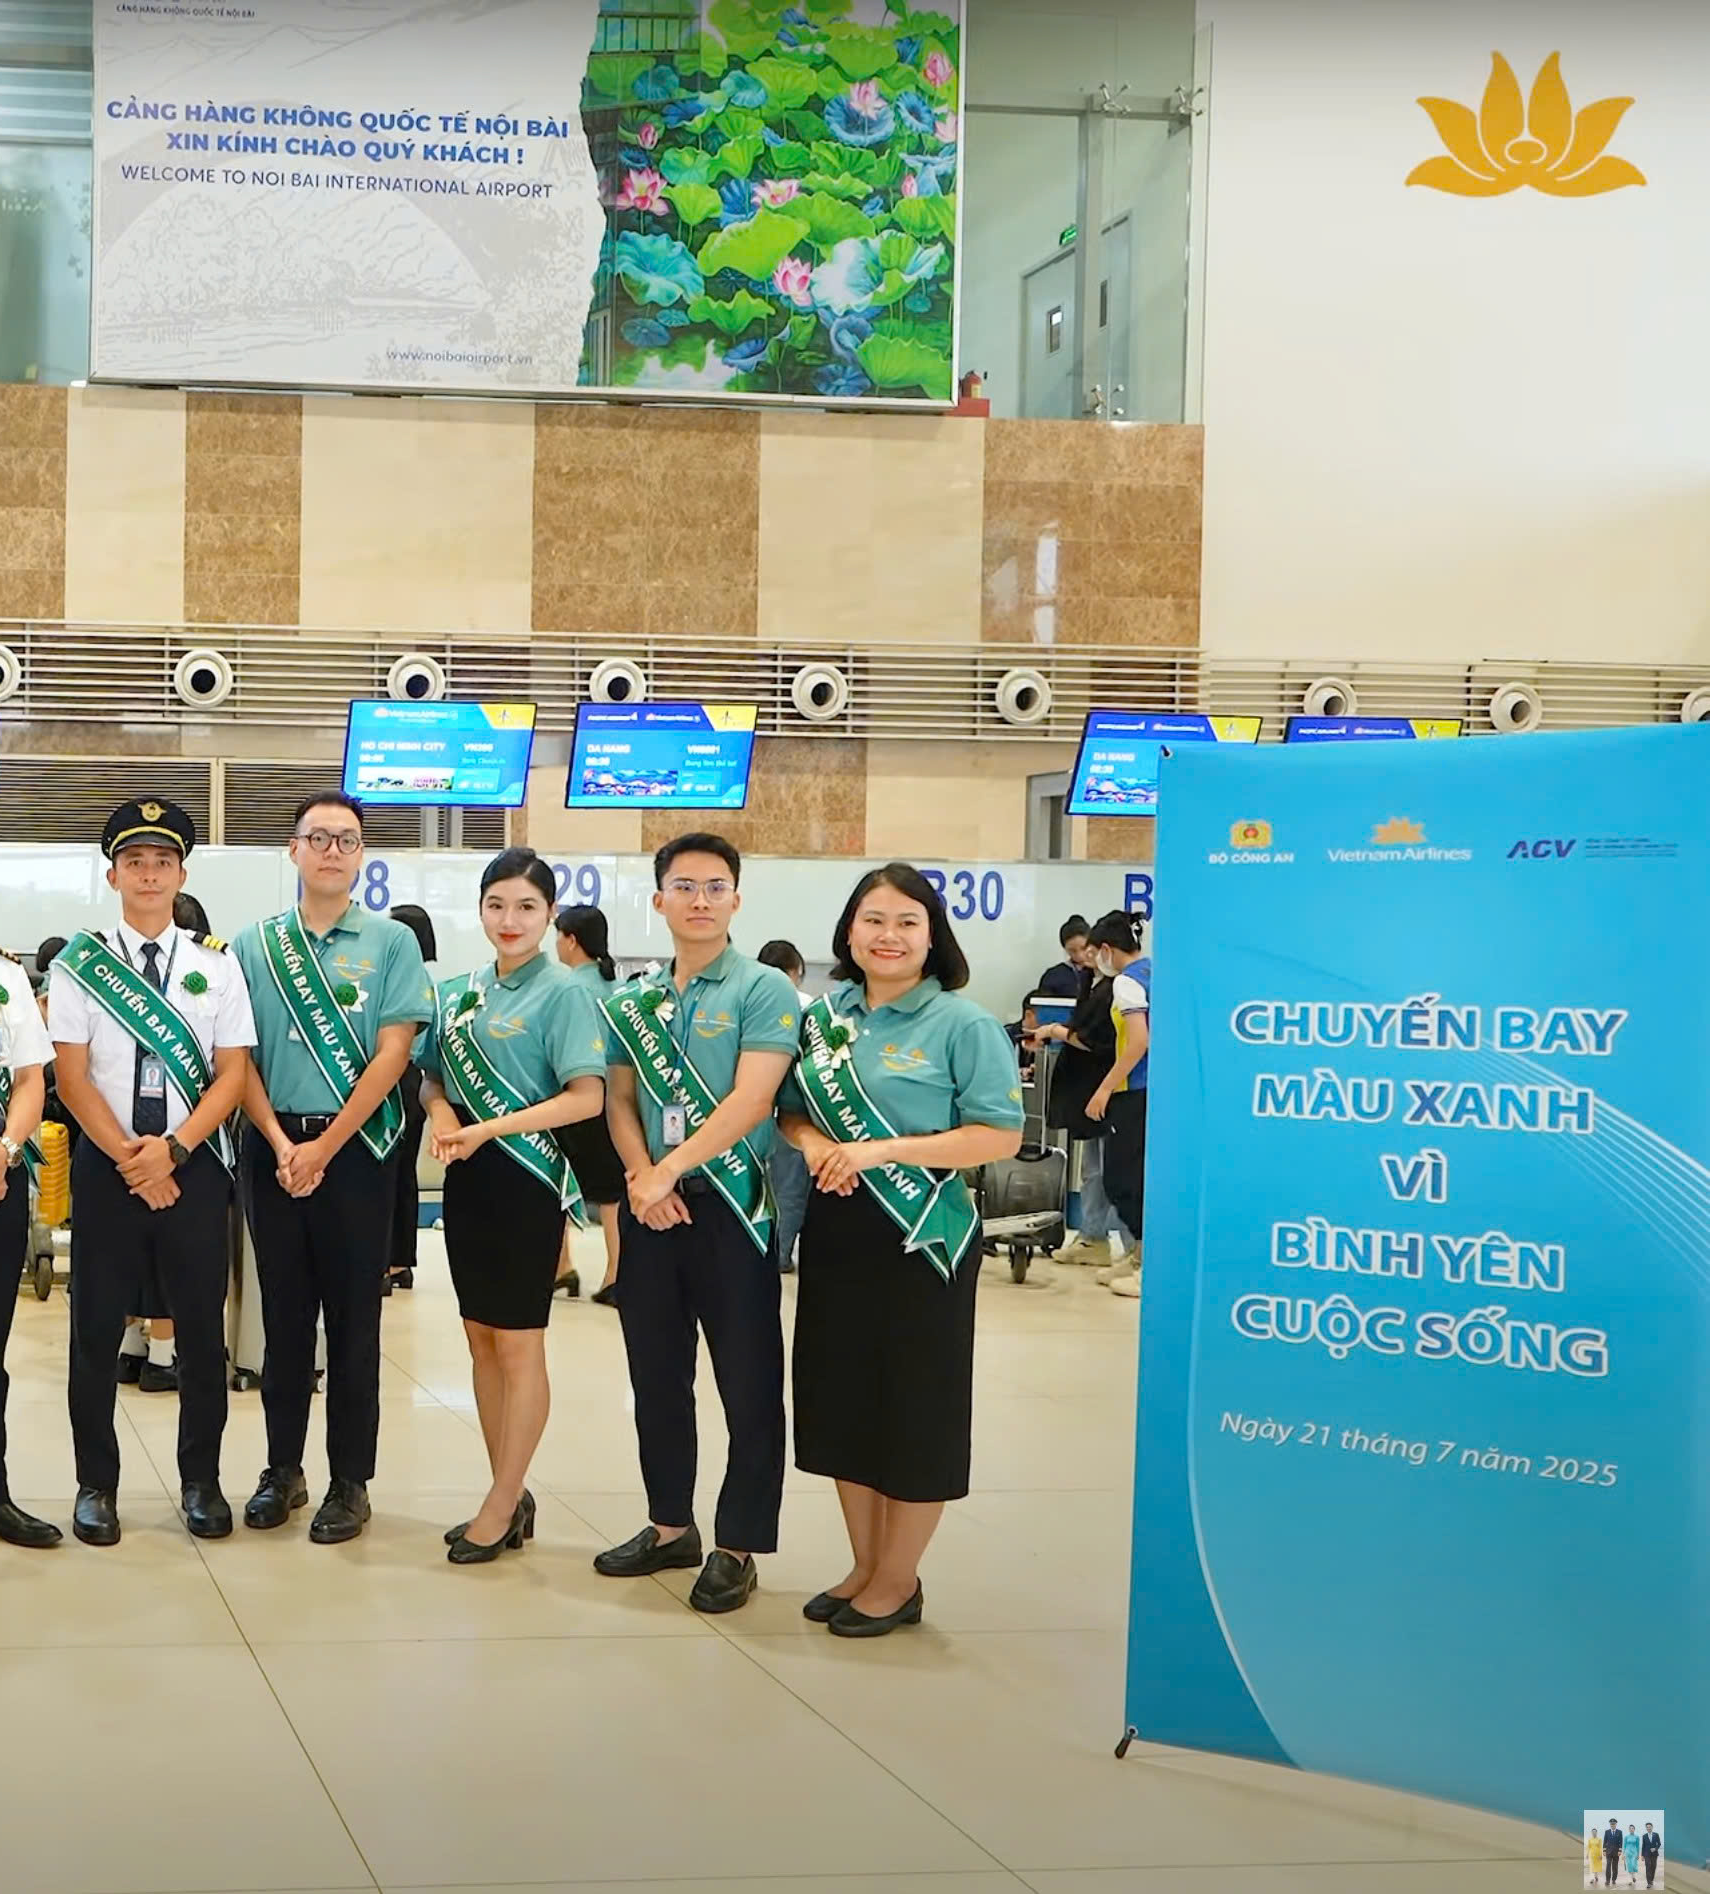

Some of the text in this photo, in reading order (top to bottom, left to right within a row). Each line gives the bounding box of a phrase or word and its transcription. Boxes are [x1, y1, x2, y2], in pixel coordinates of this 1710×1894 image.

[106, 94, 569, 140] CẢNG HÀNG KHÔNG QUỐC TẾ NỘI BÀI
[166, 132, 209, 151] XIN
[217, 130, 277, 154] KÍNH
[285, 134, 357, 158] CHÀO
[364, 138, 416, 162] QUÝ
[423, 141, 510, 164] KHÁCH
[121, 165, 553, 198] WELCOME TO NOI BAI INTERNATIONAL AIRPORT
[1231, 851, 1271, 865] CÔNG
[1273, 853, 1295, 864] AN
[93, 963, 201, 1080] CHUYẾN BAY MÀU
[293, 973, 318, 1006] BAY
[310, 1008, 339, 1047] MÀU
[619, 998, 659, 1059] CHUYẾN
[1232, 991, 1628, 1056] CHUYẾN BAY
[462, 1060, 487, 1092] BAY
[818, 1067, 848, 1105] BAY
[1252, 1066, 1595, 1135] MÀU XANH
[879, 1161, 923, 1202] ANH
[1380, 1147, 1449, 1204] VÌ
[1271, 1216, 1566, 1293] BÌNH YÊN
[1231, 1292, 1609, 1378] CUỘC SỐNG
[1219, 1411, 1620, 1488] Ngày 21 tháng 7 năm 2025
